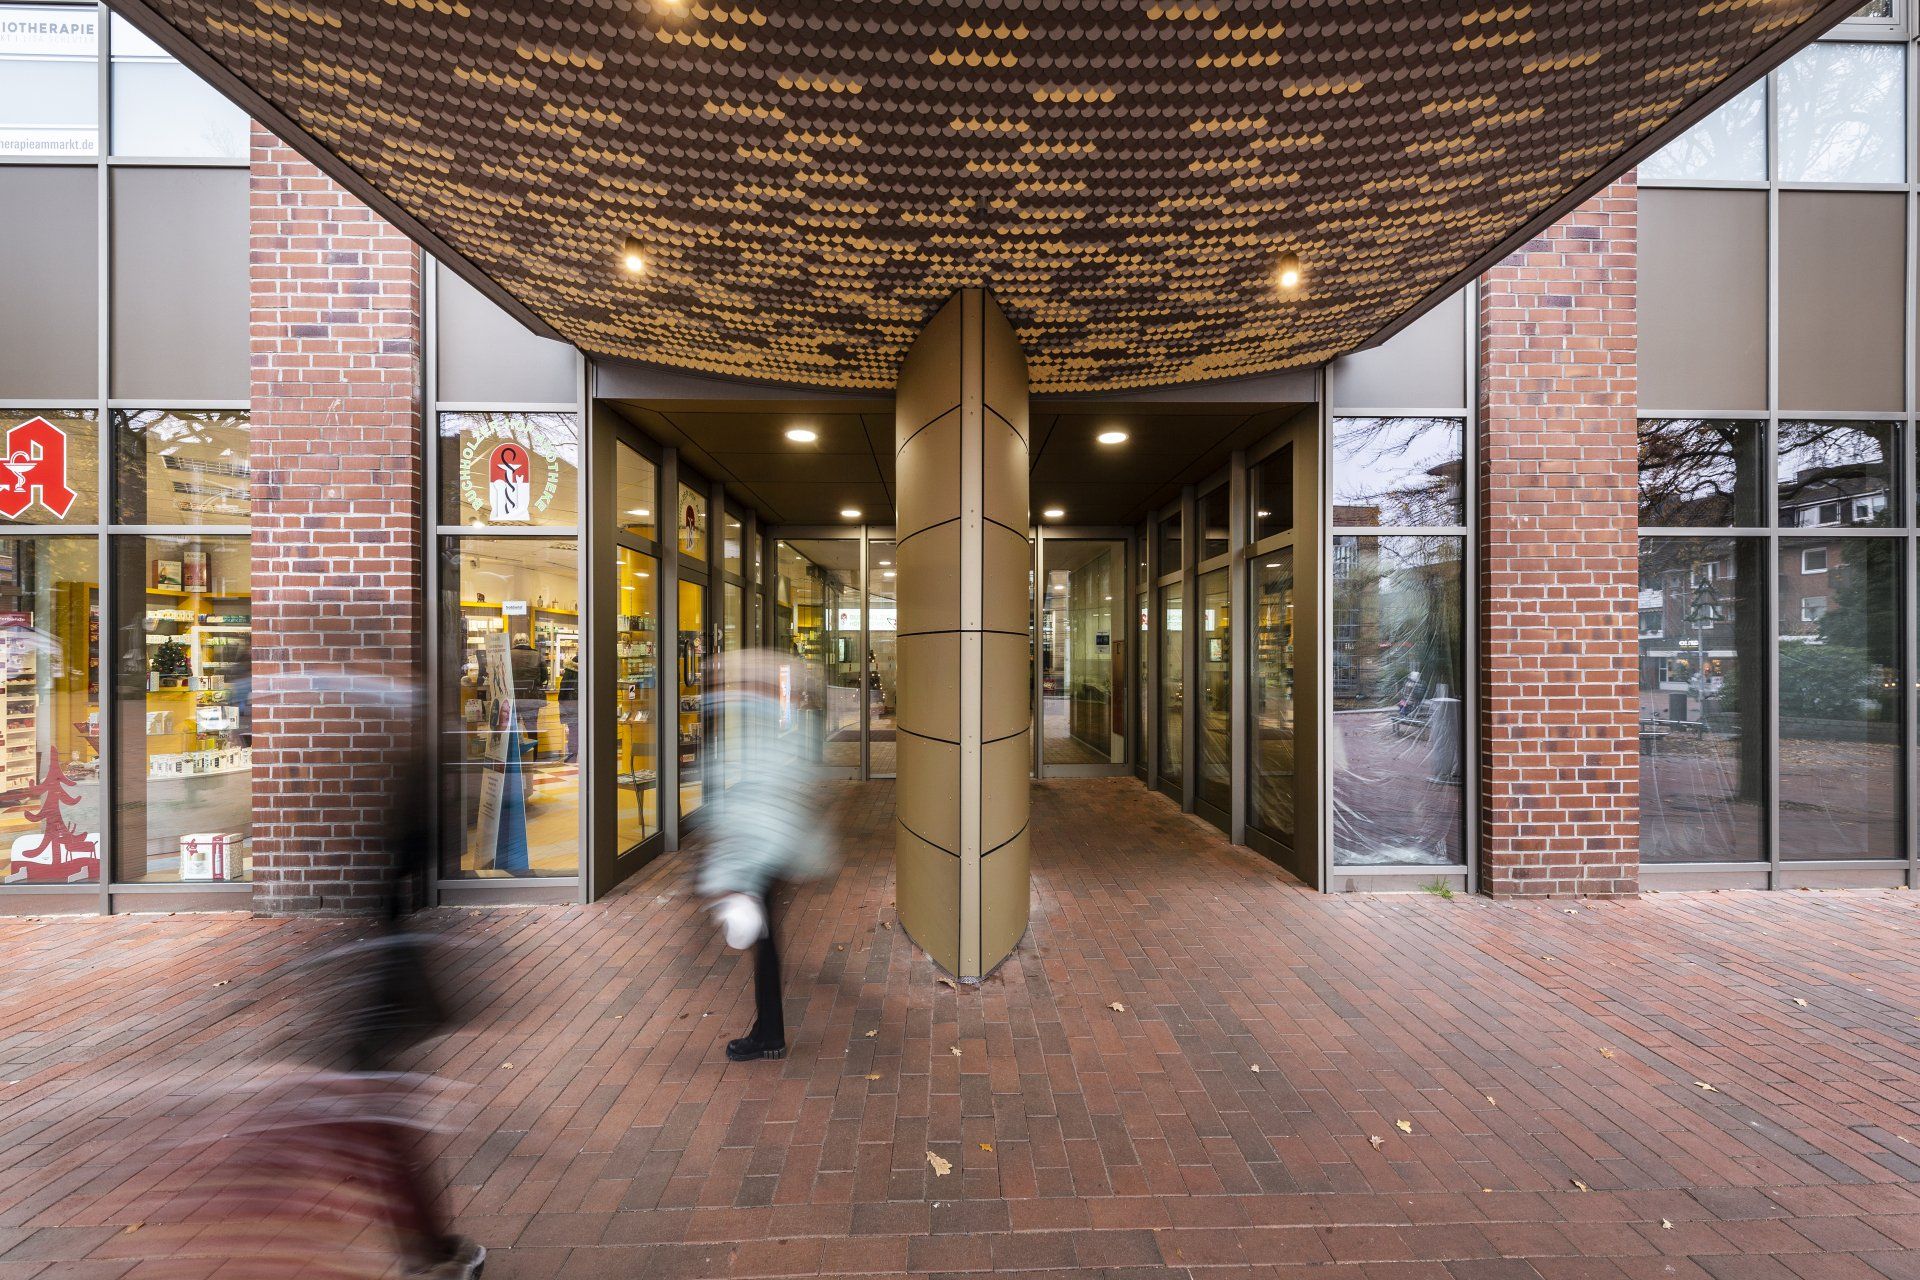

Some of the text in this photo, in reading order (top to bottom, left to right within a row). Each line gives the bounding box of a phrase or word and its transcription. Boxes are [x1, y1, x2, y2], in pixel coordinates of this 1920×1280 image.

[2, 22, 94, 35] IOTHERAPIE
[459, 420, 499, 511] BUCHHOLZER
[534, 433, 559, 512] APOTHEKE
